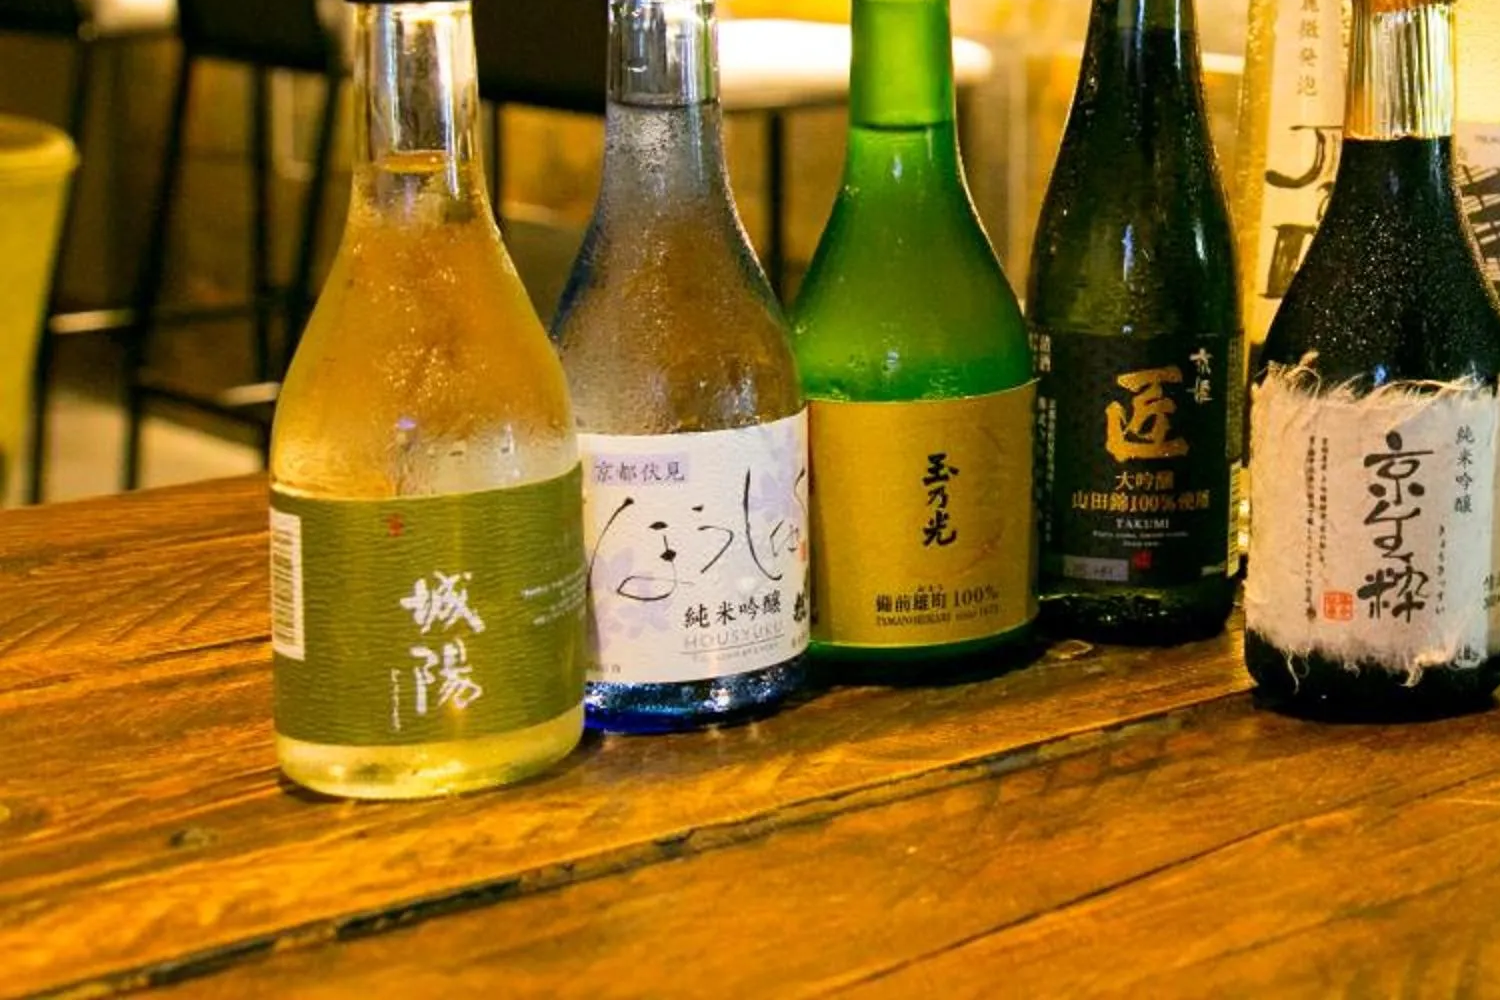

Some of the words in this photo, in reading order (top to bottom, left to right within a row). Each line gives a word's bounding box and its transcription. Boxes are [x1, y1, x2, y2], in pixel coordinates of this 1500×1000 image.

[594, 460, 685, 483] 京都伏見
[923, 453, 959, 546] 玉乃光
[1454, 424, 1475, 514] 純米吟醸
[1115, 518, 1170, 529] TAKUMI
[684, 589, 782, 629] 純米吟醸
[400, 570, 485, 716] 城陽
